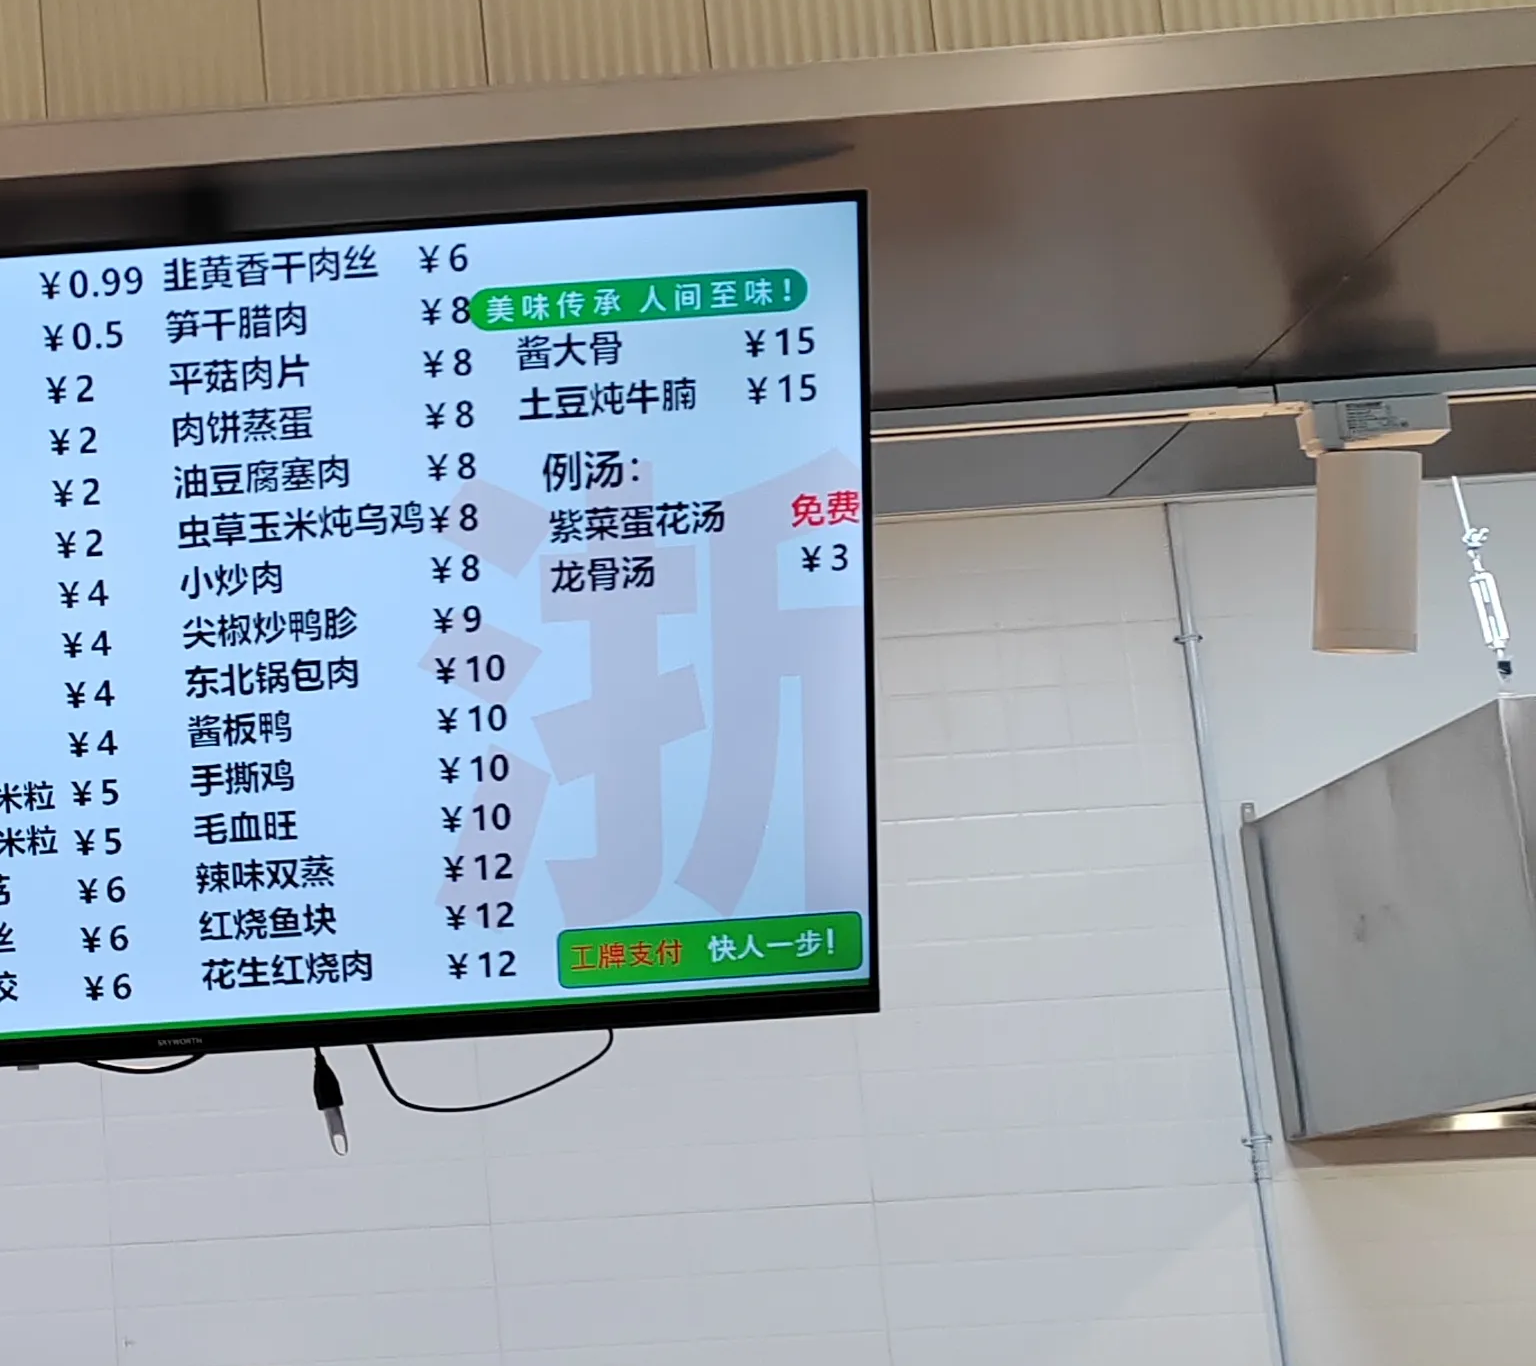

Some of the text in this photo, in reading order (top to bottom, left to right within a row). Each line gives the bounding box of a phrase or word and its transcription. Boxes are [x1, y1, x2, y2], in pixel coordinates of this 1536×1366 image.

[165, 245, 378, 291] 韭黄香干肉丝
[419, 244, 467, 273] ¥6
[40, 267, 142, 299] ¥0.99
[422, 296, 472, 325] ¥8
[486, 288, 621, 324] 美味传承
[44, 321, 122, 351] ¥0.5
[167, 302, 306, 343] 笋干腊肉
[517, 331, 622, 370] 酱大骨
[745, 327, 814, 357] ¥15
[170, 354, 309, 395] 平菇肉片
[424, 349, 471, 377] ¥8
[46, 375, 93, 404] ¥2
[519, 377, 695, 420] 土豆炖牛腩
[748, 374, 816, 404] ¥15
[173, 406, 312, 447] 肉饼蒸蛋
[426, 401, 473, 429] ¥8
[50, 427, 96, 455] ¥2
[175, 455, 348, 498] 油豆腐塞肉
[428, 453, 475, 481] ¥8
[53, 479, 100, 507] ¥2
[430, 504, 477, 533] ¥8
[550, 501, 724, 543] 紫菜蛋花汤
[791, 491, 860, 527] 免费
[179, 501, 423, 548] 虫草玉米炖乌鸡
[56, 529, 102, 558] ¥2
[802, 544, 847, 572] ¥3
[181, 561, 282, 599] 小炒肉
[432, 554, 479, 583] ¥8
[551, 556, 654, 593] 龙骨汤
[59, 580, 108, 608] ¥4
[434, 606, 481, 633] ¥9
[62, 631, 111, 658] ¥4
[186, 656, 358, 698] 东北锅包肉
[435, 655, 505, 684] ¥10
[65, 680, 115, 708] ¥4
[188, 710, 291, 748] 酱板鸭
[438, 704, 506, 733] ¥10
[69, 730, 118, 757] ¥4
[191, 759, 294, 796] 手撕鸡
[440, 754, 509, 783] ¥10
[71, 779, 118, 806] ¥5
[194, 811, 297, 844] 毛血旺
[442, 803, 511, 832] ¥10
[75, 828, 121, 855] ¥5
[196, 855, 334, 894] 辣味双蒸
[444, 853, 512, 882] ¥12
[78, 876, 125, 903] ¥6
[199, 903, 336, 940] 红烧鱼块
[446, 902, 514, 930] ¥12
[81, 925, 128, 952] ¥6
[202, 950, 372, 990] 花生红烧肉
[448, 951, 516, 979] ¥12
[570, 939, 683, 972] 工牌支付
[84, 974, 131, 1000] ¥6
